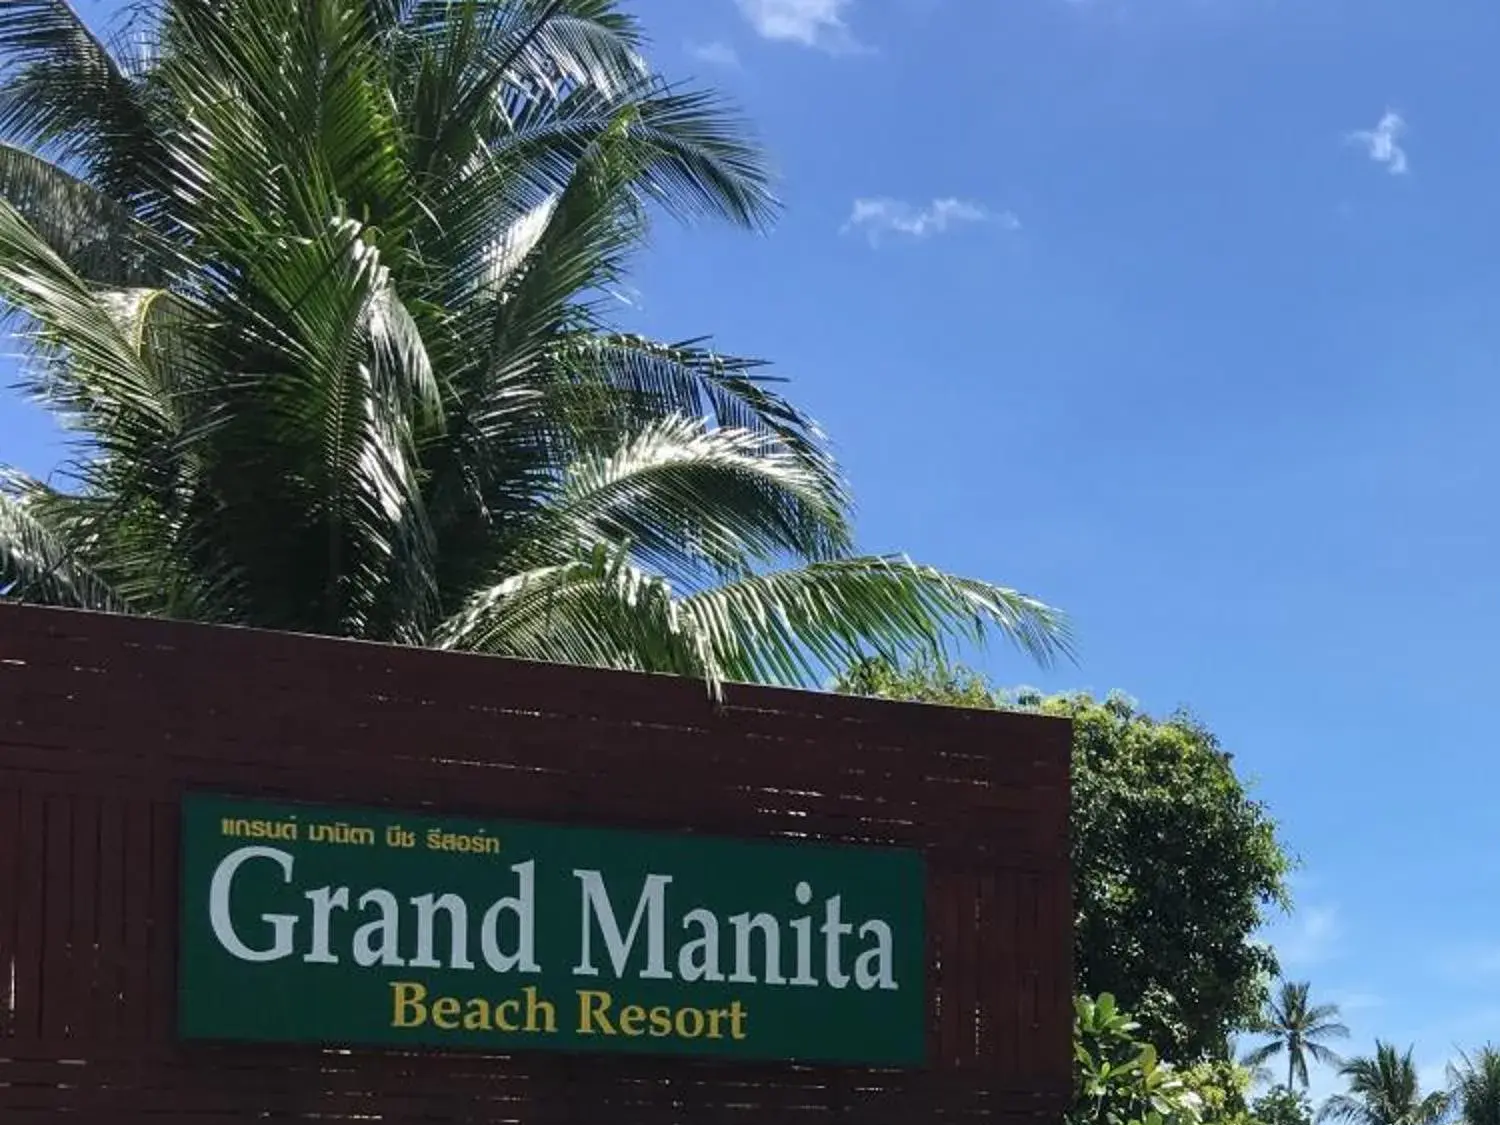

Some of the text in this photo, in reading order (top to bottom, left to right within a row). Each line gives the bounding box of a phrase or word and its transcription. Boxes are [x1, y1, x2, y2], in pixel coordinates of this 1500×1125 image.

[221, 815, 298, 840] แกรนด์
[386, 825, 416, 849] บีช
[209, 845, 899, 991] Grand Manita
[390, 981, 748, 1040] Beach Resort
